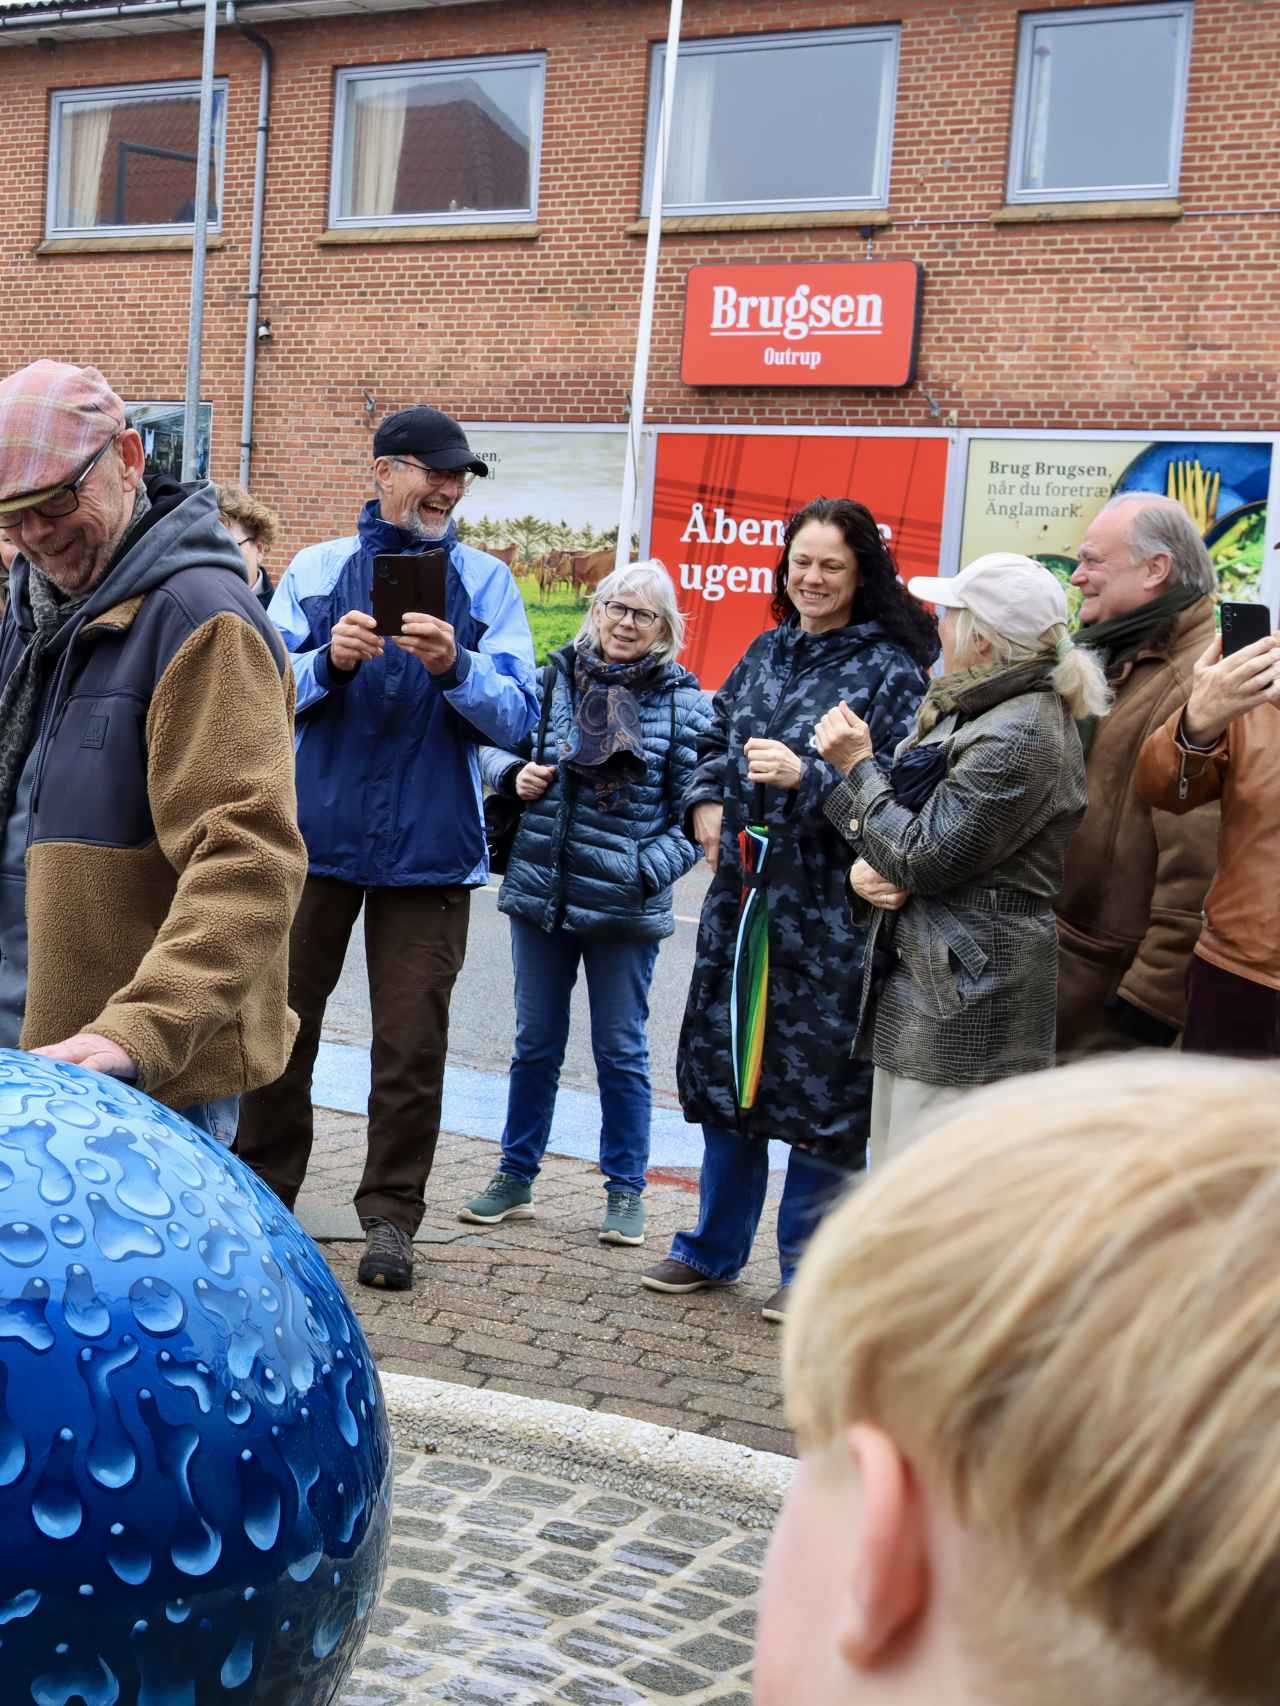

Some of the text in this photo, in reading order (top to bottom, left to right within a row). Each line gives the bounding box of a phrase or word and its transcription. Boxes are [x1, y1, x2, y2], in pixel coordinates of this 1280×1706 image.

[710, 284, 883, 341] Brugsen
[763, 347, 821, 369] Outrup
[989, 460, 1113, 480] Brug Brugsen,
[987, 481, 1016, 496] når
[1020, 481, 1041, 497] du
[985, 499, 1083, 519] Änglamark.
[680, 502, 785, 546] Åben
[679, 563, 774, 601] ugen
